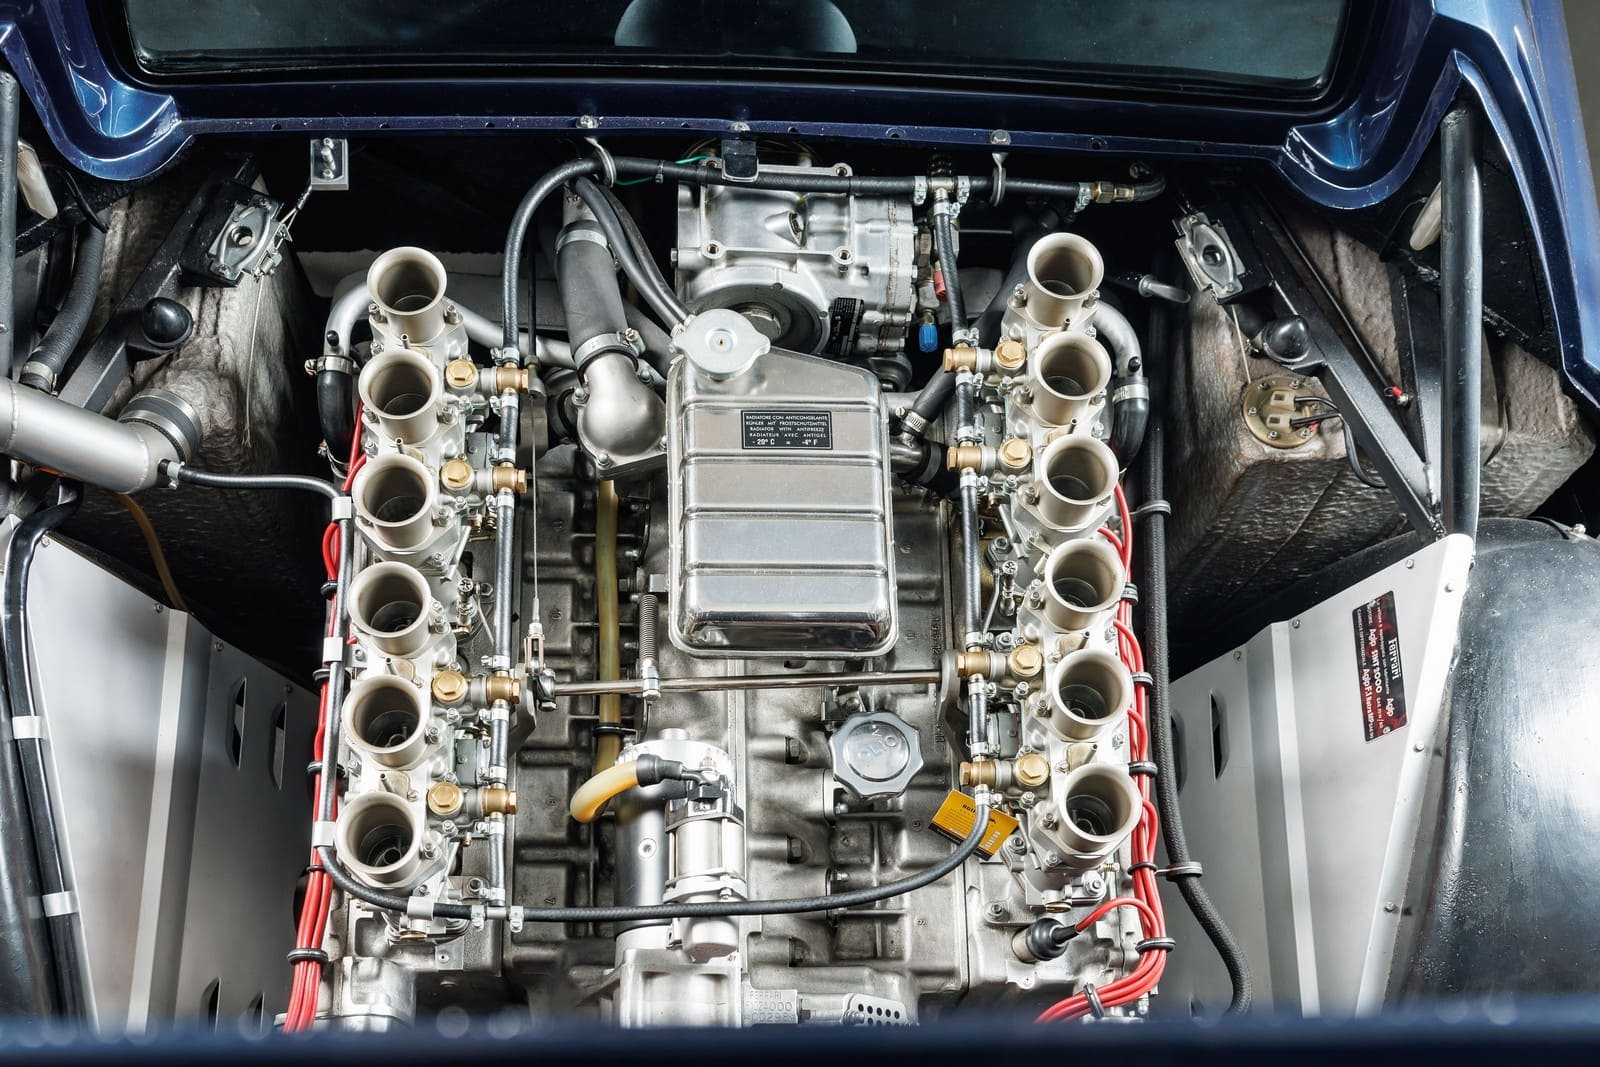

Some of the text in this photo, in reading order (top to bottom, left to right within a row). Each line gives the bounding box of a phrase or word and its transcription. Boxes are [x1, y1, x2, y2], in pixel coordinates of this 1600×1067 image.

[1368, 629, 1378, 647] Agip
[1388, 637, 1402, 680] Ferrari
[1385, 698, 1395, 717] Agip
